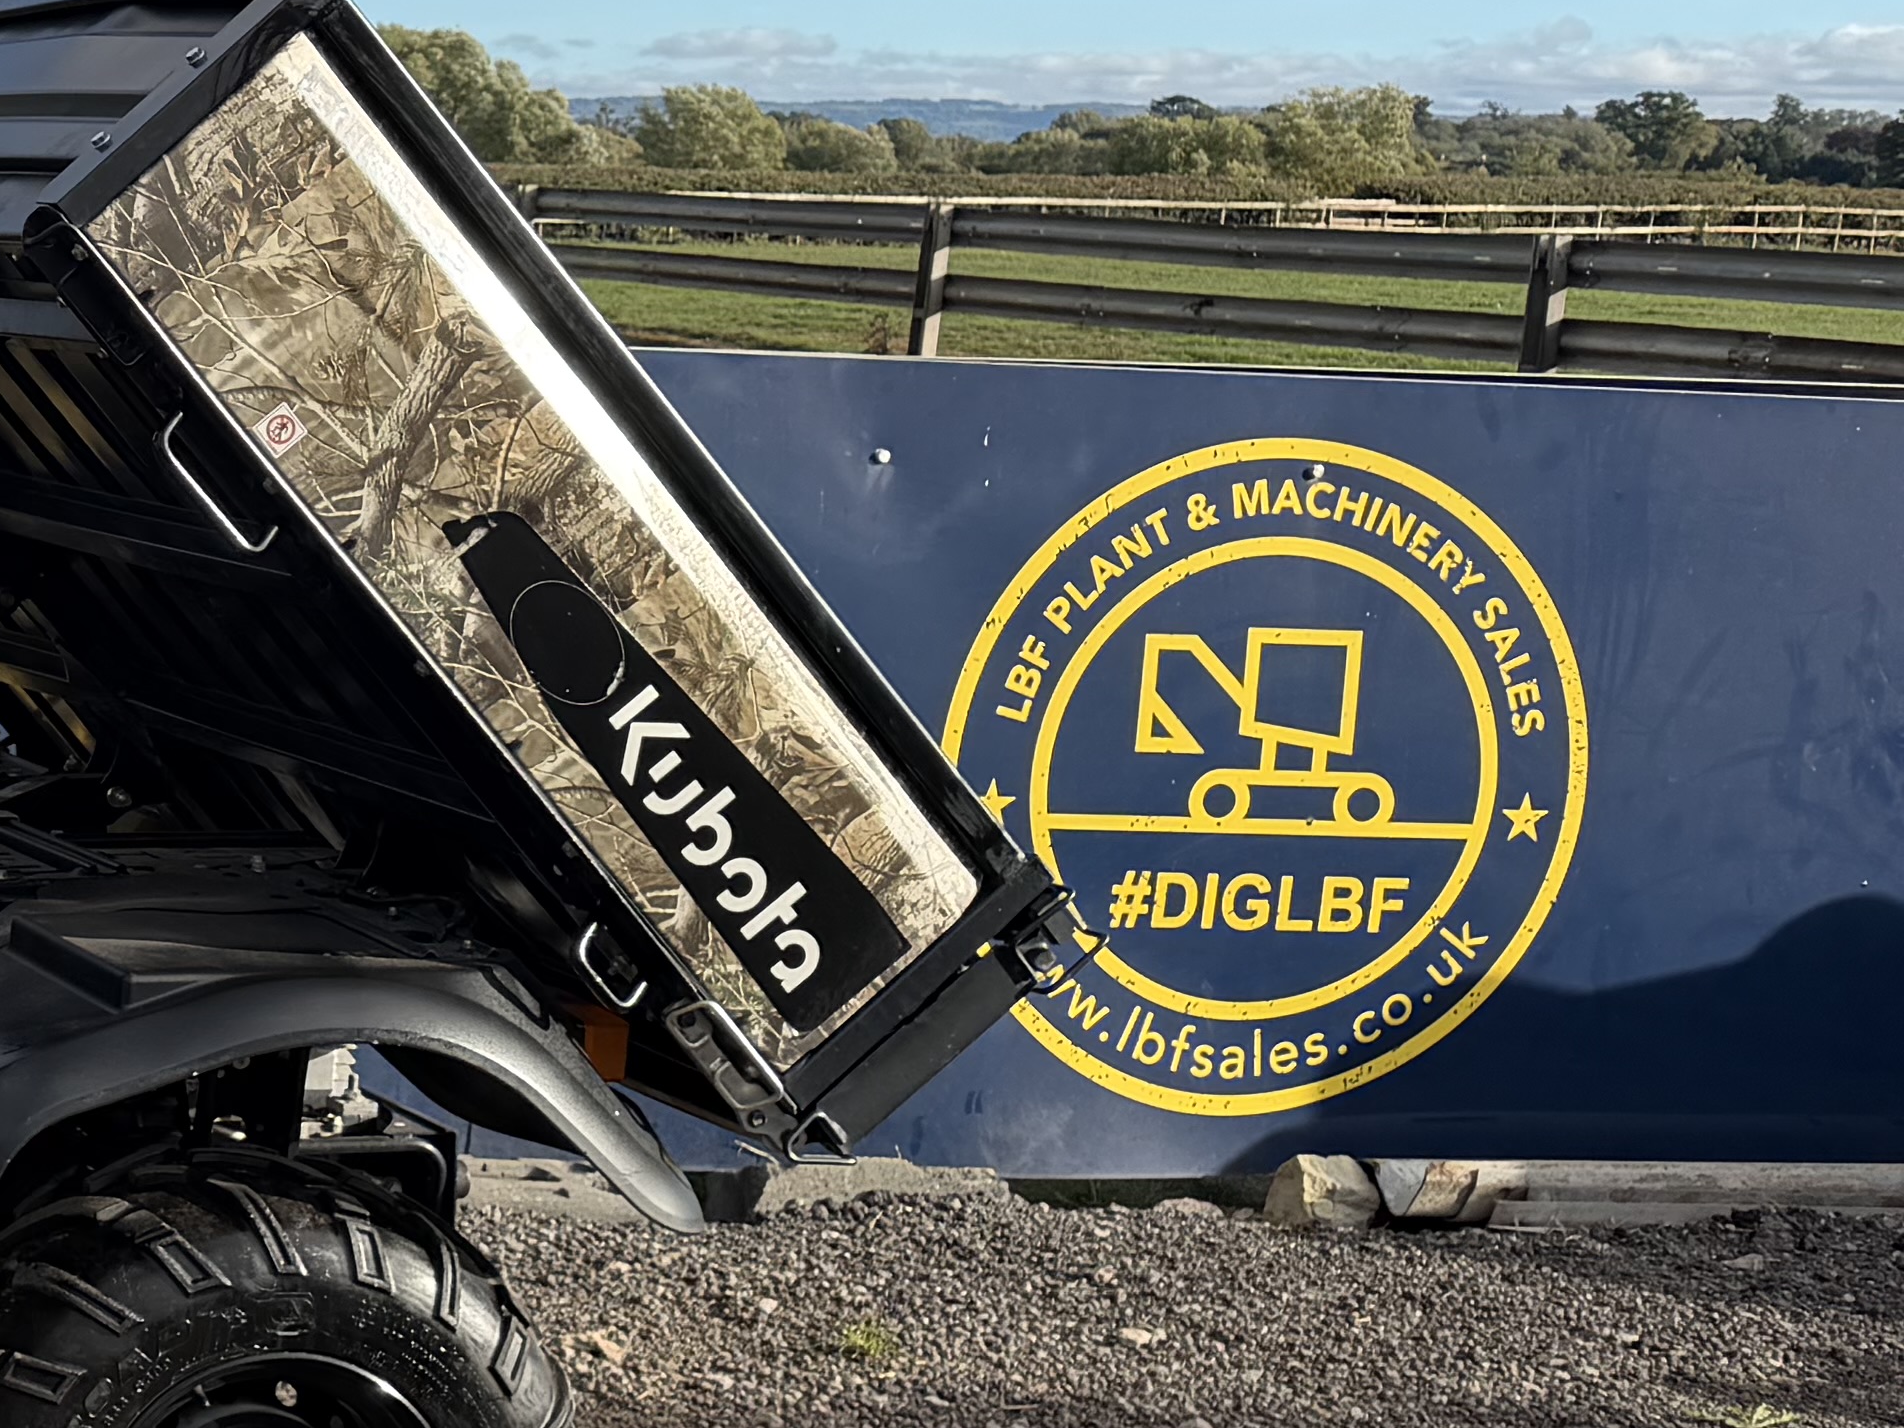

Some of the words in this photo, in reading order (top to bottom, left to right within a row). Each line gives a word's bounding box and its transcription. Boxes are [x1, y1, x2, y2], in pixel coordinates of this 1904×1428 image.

[996, 635, 1051, 724] LBF
[1044, 508, 1171, 635] PLANT
[1187, 493, 1221, 532] &
[1231, 479, 1487, 595] MACHINERY
[1473, 596, 1547, 738] SALES
[608, 684, 821, 993] Kubota
[1108, 870, 1411, 935] #DIGLBF
[1036, 918, 1489, 1081] ww.lbfsales.co.uk
